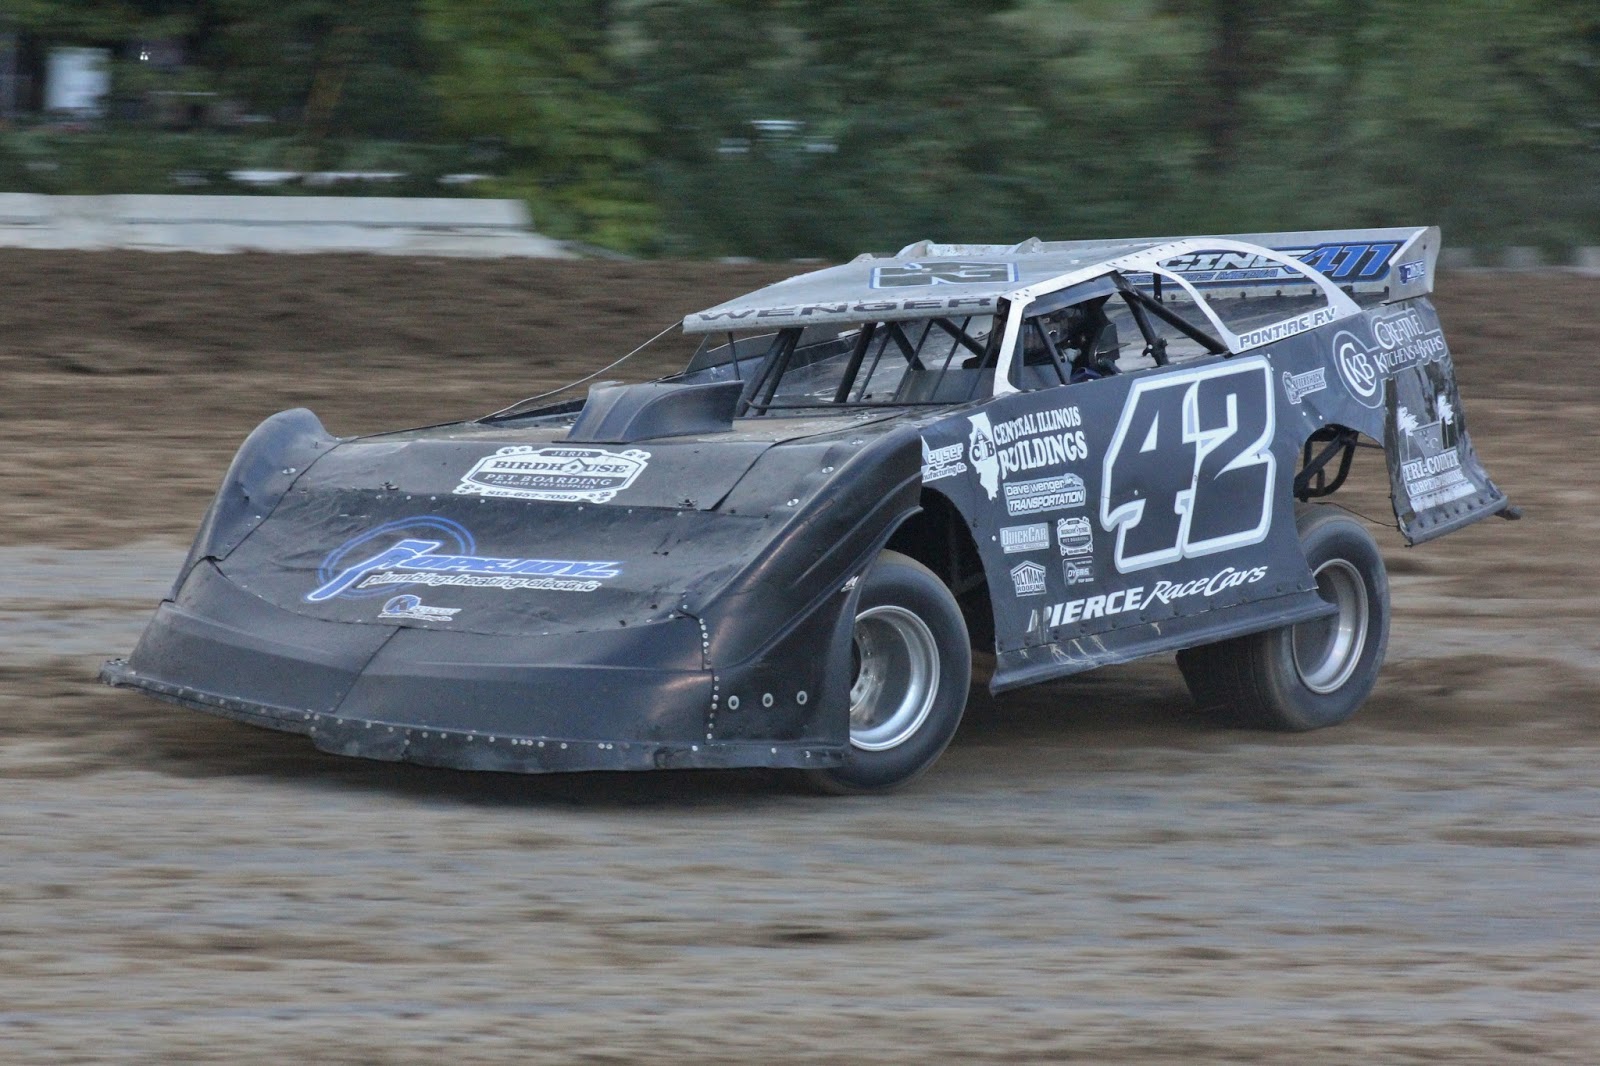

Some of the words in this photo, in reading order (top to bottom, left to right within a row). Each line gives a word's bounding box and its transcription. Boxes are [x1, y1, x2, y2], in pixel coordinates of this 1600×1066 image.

[1215, 268, 1279, 281] MEDIA
[1283, 243, 1401, 279] 411
[700, 298, 992, 321] WENGER
[1240, 314, 1313, 349] PONTIAC
[1314, 306, 1339, 326] RV
[1374, 314, 1424, 350] CREATIVE
[1340, 342, 1377, 397] CKB
[993, 412, 1038, 446] CENTRAL
[1036, 405, 1082, 434] ILLINOIS
[551, 450, 592, 458] JERIS
[998, 430, 1088, 480] BUILDINGS
[1101, 354, 1278, 574] 42
[1402, 449, 1460, 481] TRI-COUNTY
[484, 473, 518, 482] PET
[521, 474, 613, 485] BOARDING
[1005, 482, 1030, 496] Dave
[1008, 490, 1085, 512] TRANSPORTATION
[1015, 567, 1044, 586] OLTMAN
[1016, 583, 1045, 593] ROOFING
[1026, 586, 1144, 634] PIERCE
